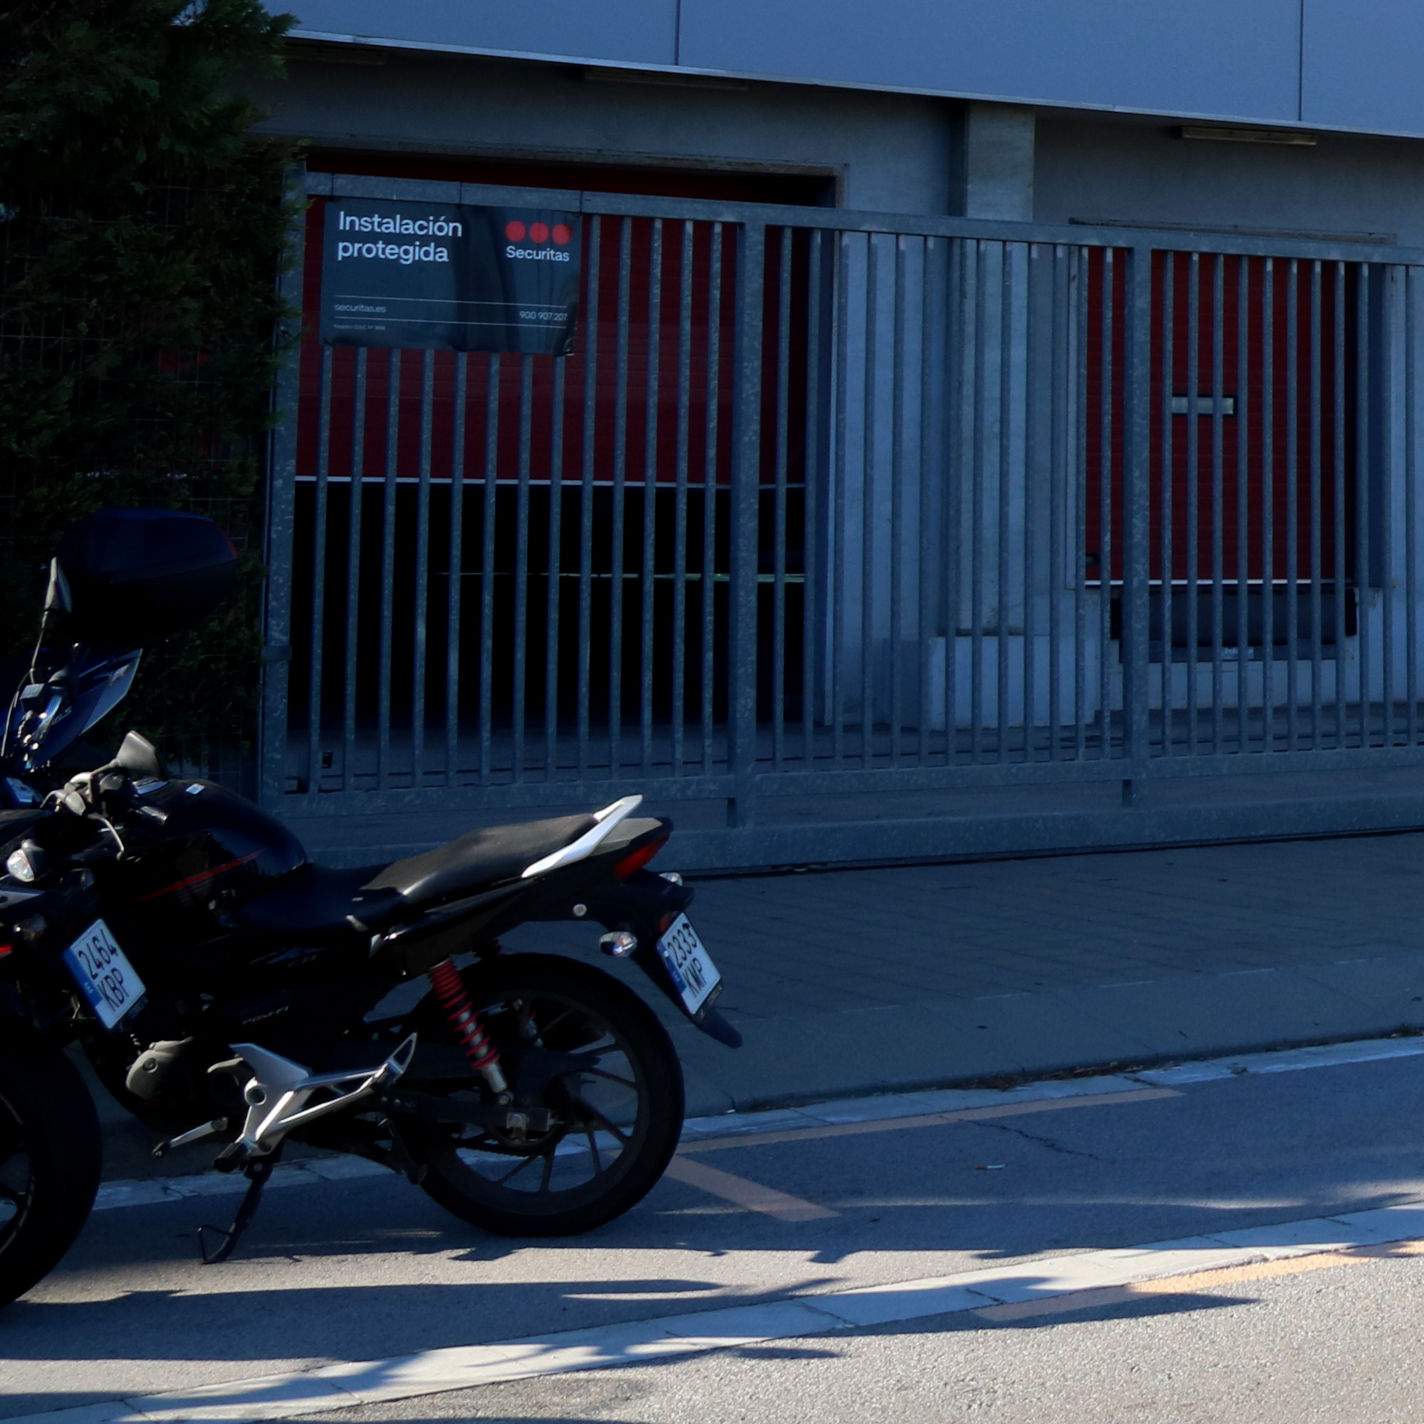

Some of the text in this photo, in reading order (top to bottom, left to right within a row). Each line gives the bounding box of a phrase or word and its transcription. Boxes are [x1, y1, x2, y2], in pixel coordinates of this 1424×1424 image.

[339, 211, 462, 237] Instalación
[338, 241, 449, 264] protegida
[505, 245, 570, 262] Securitas
[520, 310, 537, 320] 900
[78, 929, 117, 980] 2464
[667, 923, 698, 968] 2333
[97, 968, 130, 1012] KBP
